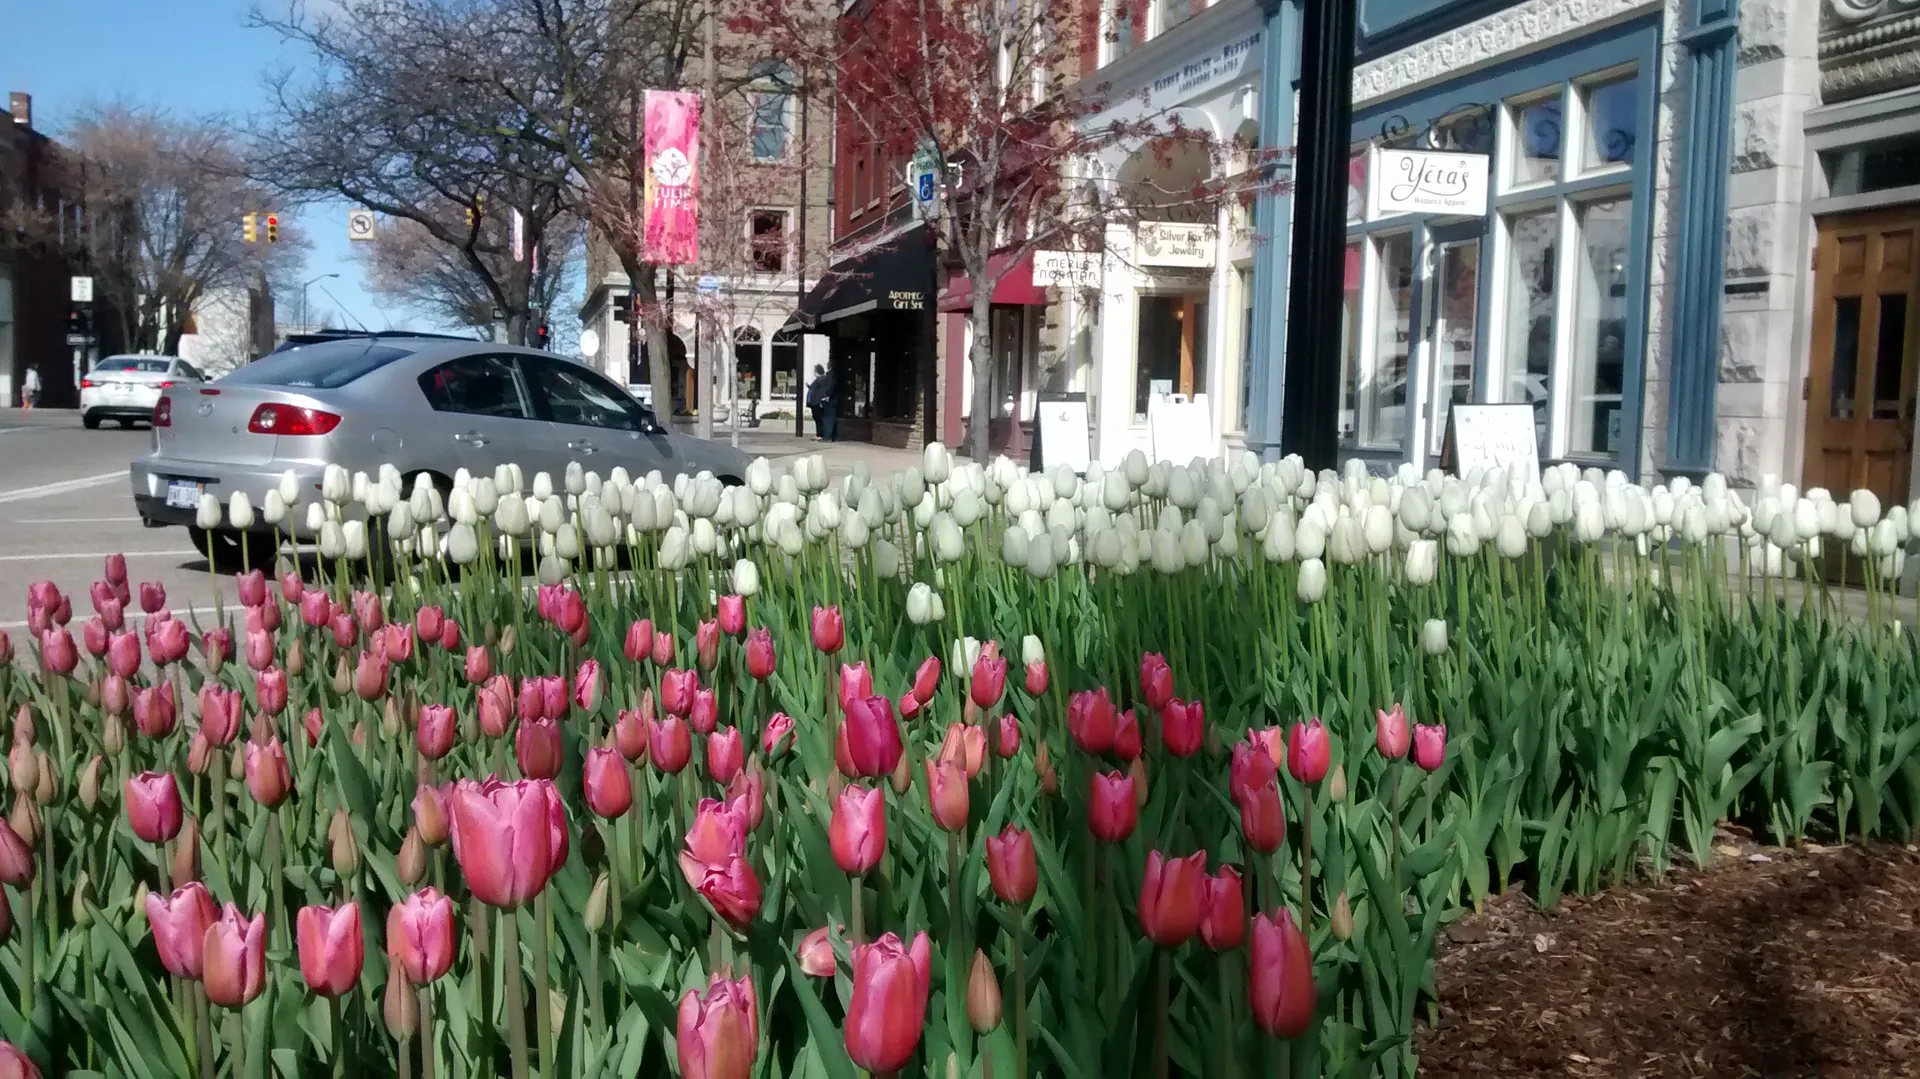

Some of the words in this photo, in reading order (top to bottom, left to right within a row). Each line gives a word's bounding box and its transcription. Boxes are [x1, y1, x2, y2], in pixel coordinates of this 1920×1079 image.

[654, 187, 691, 199] TULIP
[654, 198, 690, 210] TIME
[1160, 229, 1186, 241] Silver
[1168, 244, 1204, 259] Jewelry
